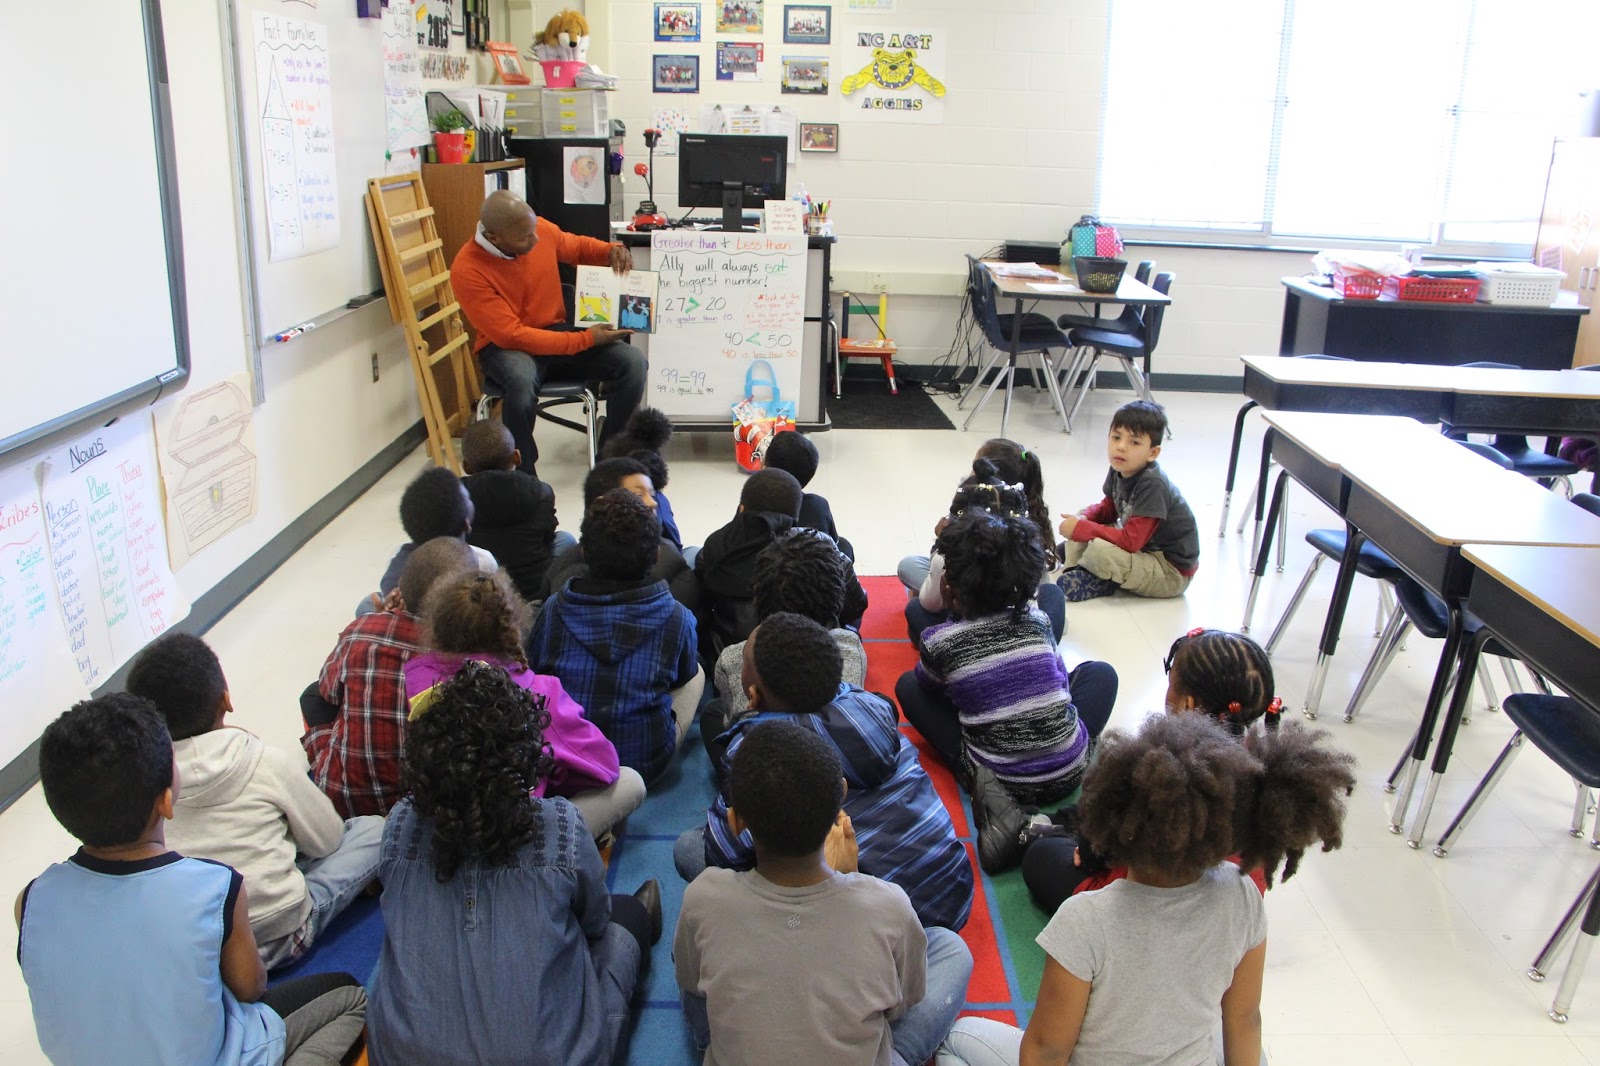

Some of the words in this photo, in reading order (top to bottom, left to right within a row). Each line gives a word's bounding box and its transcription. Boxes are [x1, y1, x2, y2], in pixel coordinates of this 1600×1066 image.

[263, 17, 280, 39] Fact
[287, 21, 316, 41] Families
[857, 32, 885, 48] NC
[888, 33, 932, 49] A&T
[862, 97, 923, 110] AGGIES
[653, 233, 694, 249] Greater
[699, 235, 717, 249] than
[736, 237, 761, 250] Less
[764, 238, 791, 250] than
[660, 254, 684, 277] Ally
[695, 258, 714, 271] will
[721, 259, 759, 276] always
[764, 258, 788, 273] eat
[678, 273, 717, 295] biggest
[724, 276, 768, 288] number!
[665, 297, 686, 312] 27
[705, 297, 727, 311] 20
[724, 331, 744, 346] 40
[764, 334, 792, 348] 50
[656, 384, 667, 392] 99
[69, 437, 104, 468] Nouns
[86, 475, 110, 501] Place
[0, 502, 39, 530] cribes
[46, 499, 79, 526] Person
[19, 546, 43, 567] Color
[69, 616, 88, 637] mom
[71, 630, 86, 653] dad
[77, 655, 93, 677] boy
